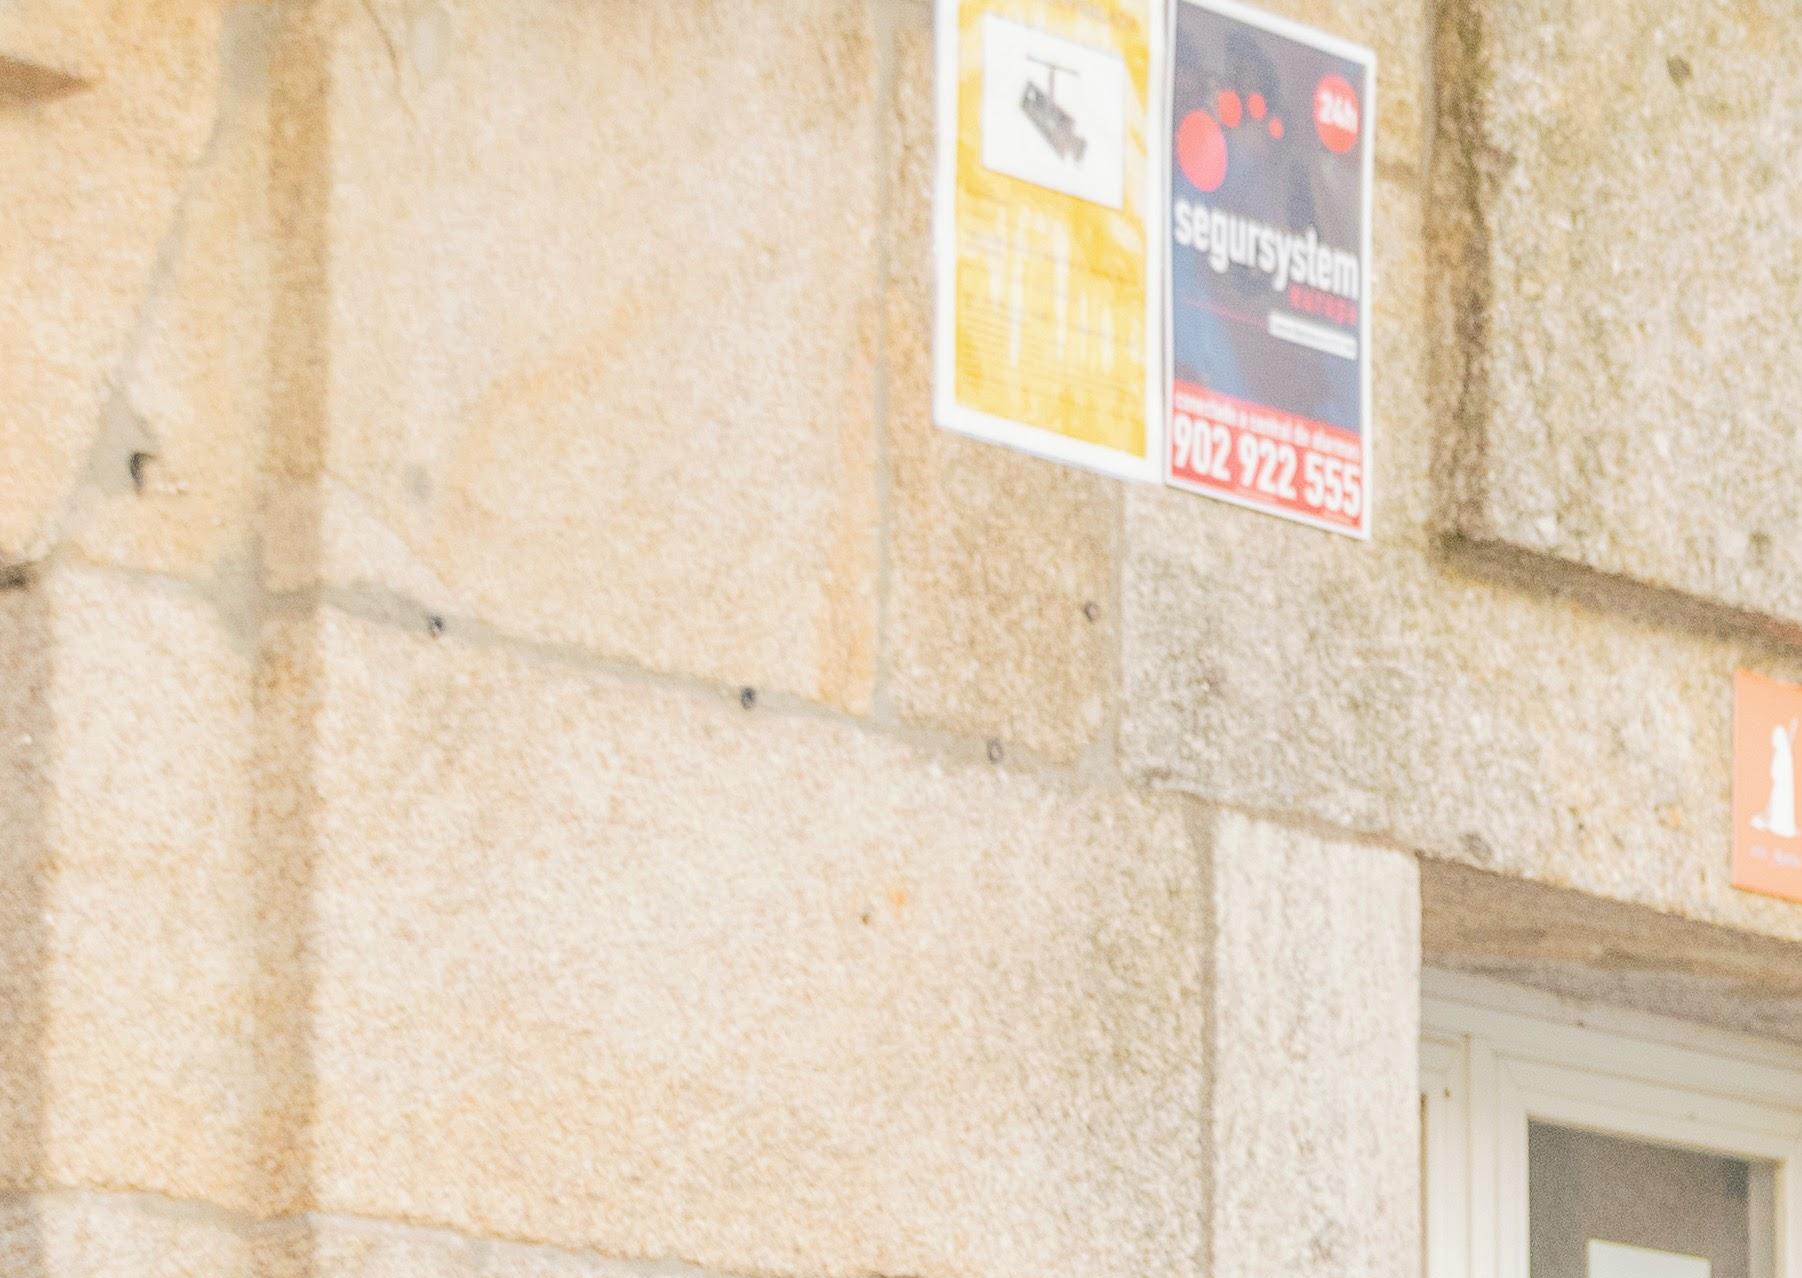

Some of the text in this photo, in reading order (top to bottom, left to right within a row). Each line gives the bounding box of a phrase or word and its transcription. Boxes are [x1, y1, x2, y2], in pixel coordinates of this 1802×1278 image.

[1175, 199, 1359, 300] segursystem
[1173, 414, 1361, 516] 902 922 555
